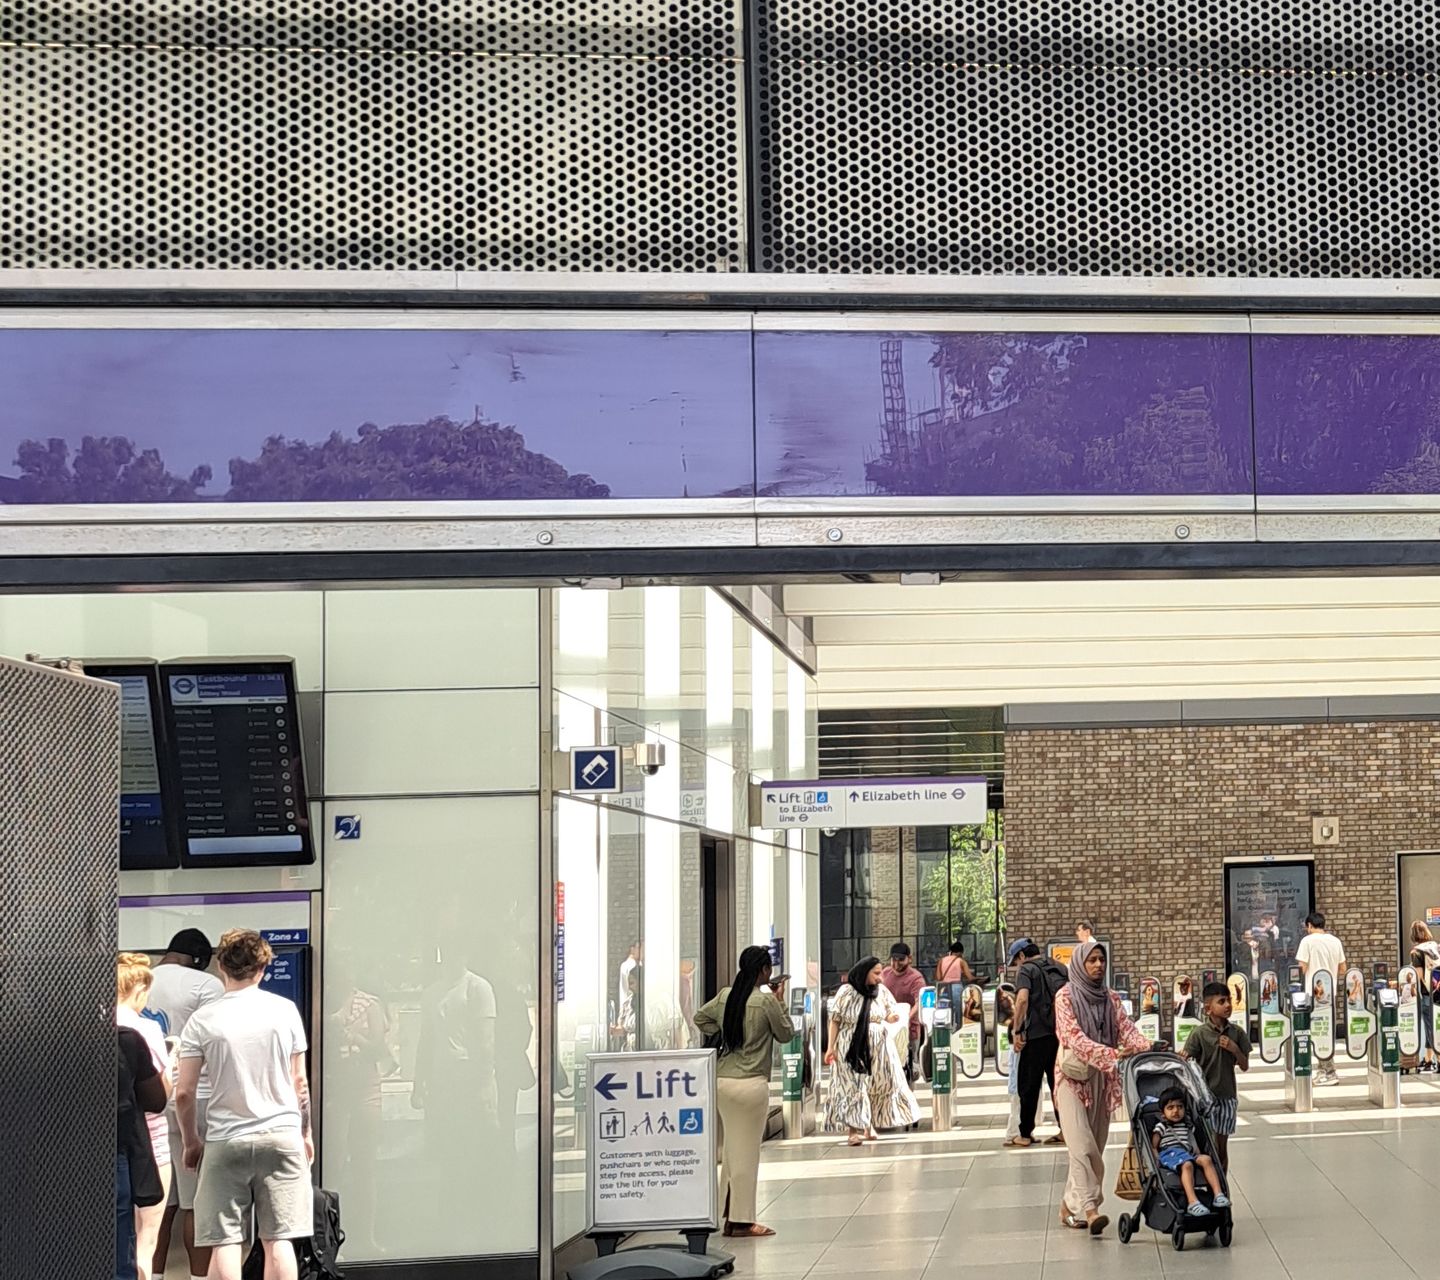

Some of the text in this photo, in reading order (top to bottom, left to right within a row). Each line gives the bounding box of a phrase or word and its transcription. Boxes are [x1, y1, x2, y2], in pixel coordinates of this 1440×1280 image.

[779, 792, 800, 804] Lift
[862, 789, 947, 801] Elizabeth line
[792, 804, 832, 813] Elizabeth
[268, 932, 300, 941] Zone 4
[636, 1069, 697, 1100] Lift
[600, 1151, 642, 1160] Customers
[600, 1161, 641, 1171] pushchairs
[673, 1158, 700, 1166] require
[600, 1172, 617, 1180] step
[638, 1170, 666, 1178] access,
[668, 1168, 694, 1177] please
[632, 1180, 645, 1188] lift
[647, 1179, 658, 1187] for
[660, 1179, 678, 1188] your
[619, 1190, 645, 1199] safety.
